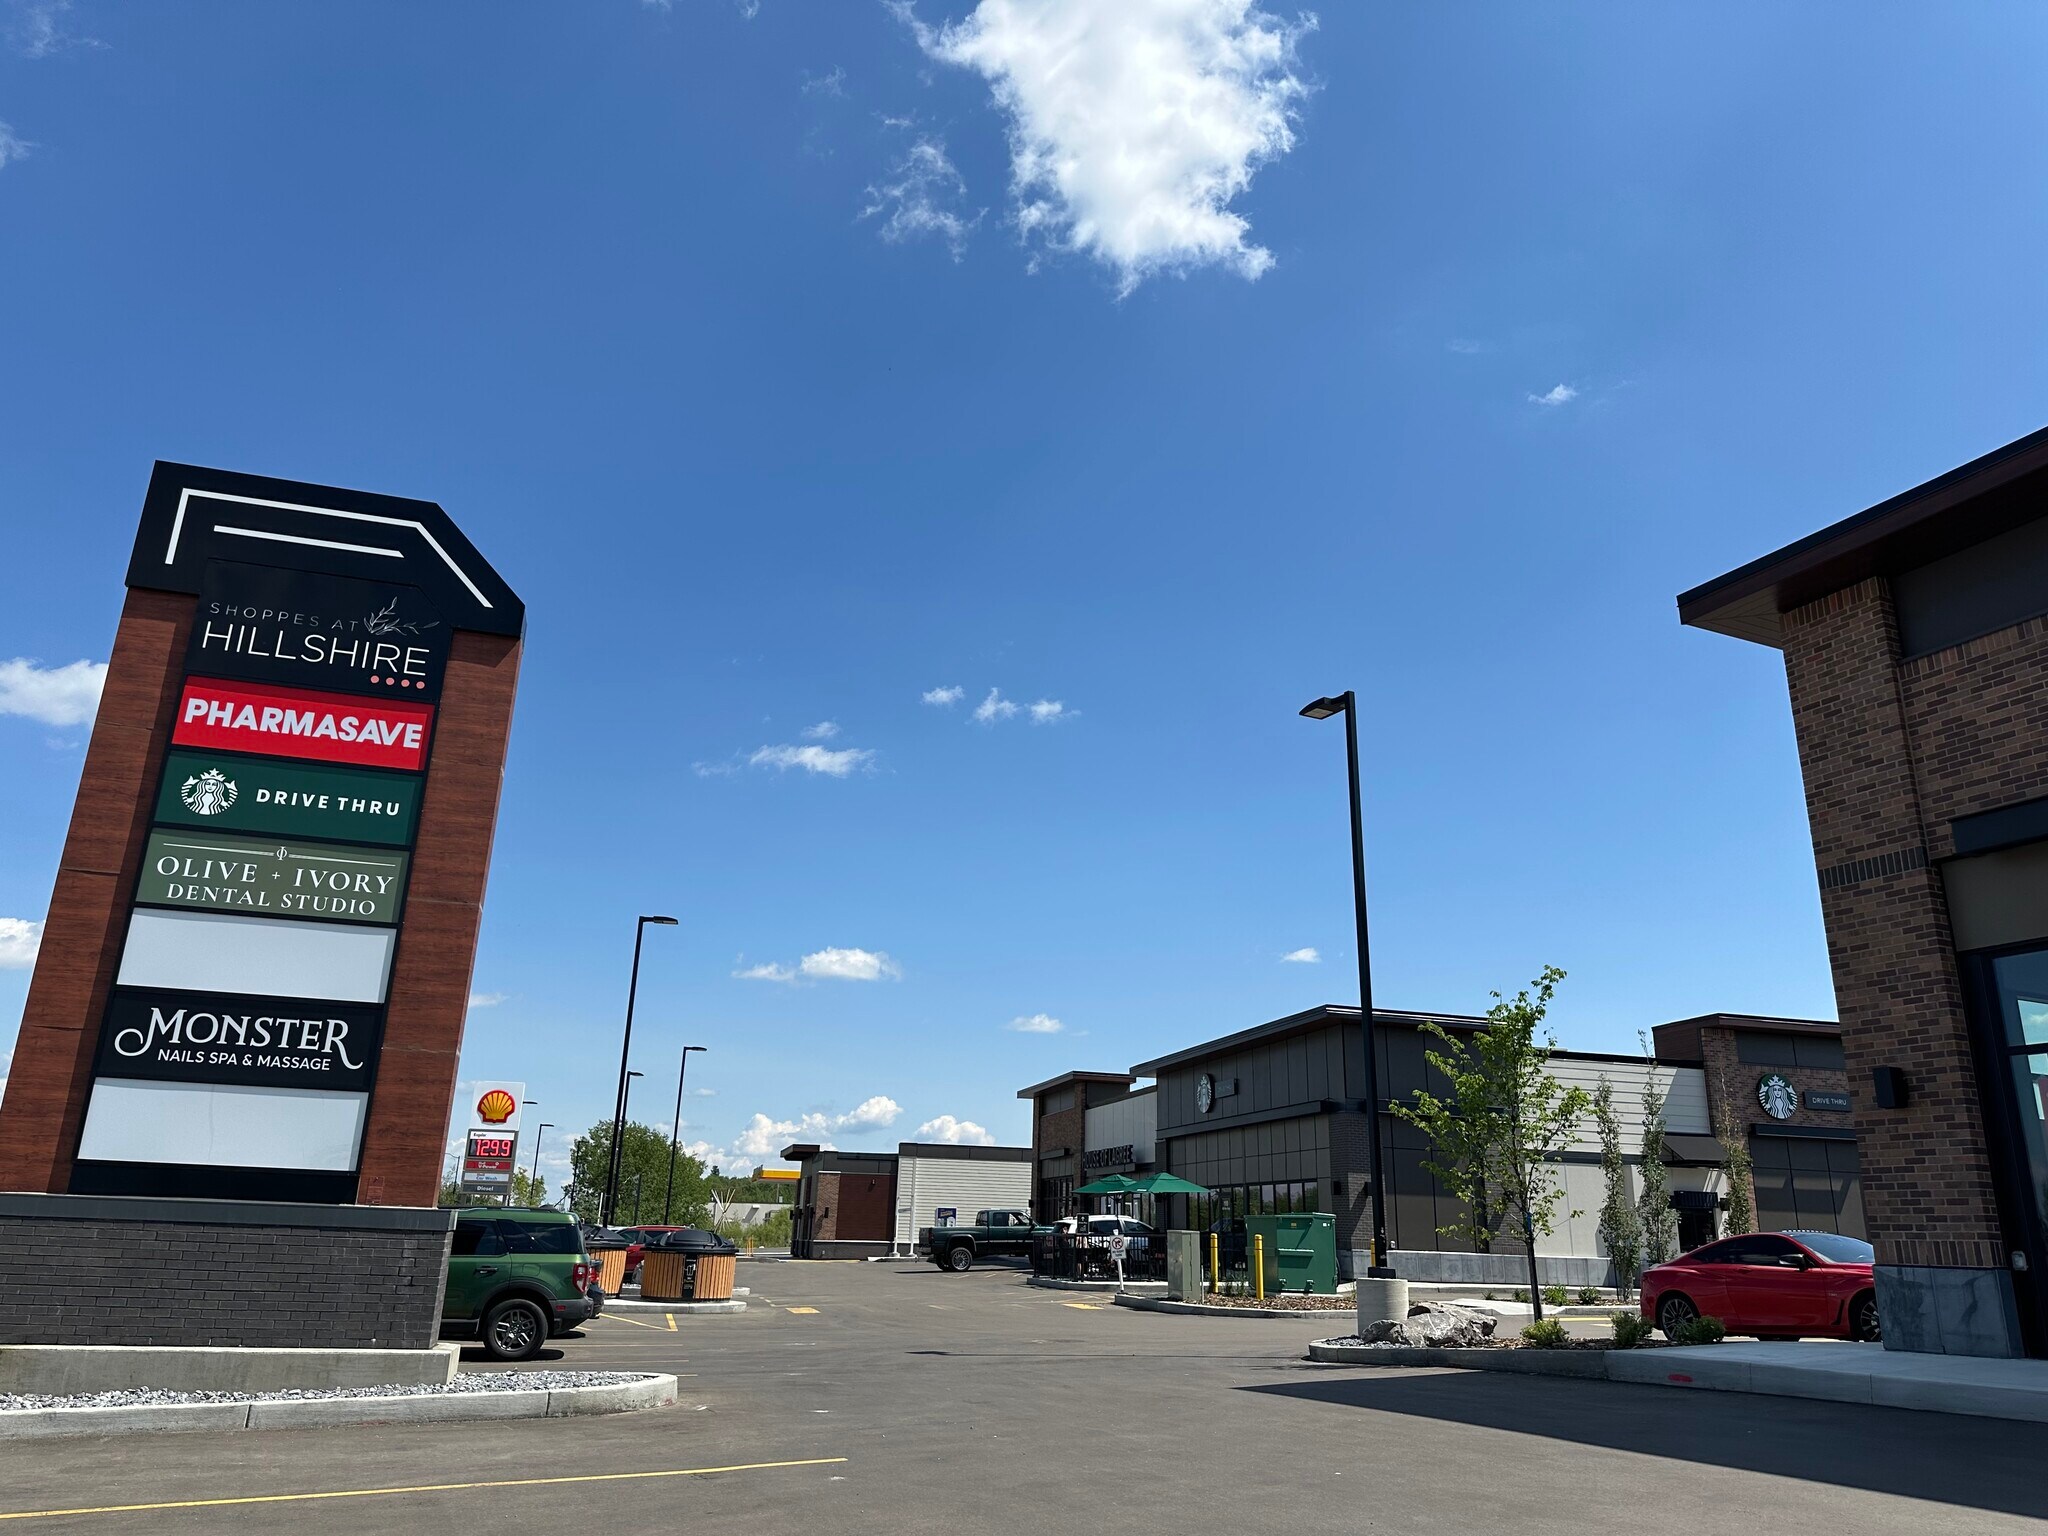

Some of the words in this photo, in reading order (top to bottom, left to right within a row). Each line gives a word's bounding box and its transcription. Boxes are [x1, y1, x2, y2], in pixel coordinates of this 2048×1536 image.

[209, 602, 319, 627] SHOPPES
[331, 618, 358, 632] AT
[202, 620, 430, 676] HILLSHIRE
[184, 697, 423, 749] PHARMASAVE
[256, 788, 328, 809] DRIVE
[338, 797, 400, 816] THRU
[156, 855, 258, 883] OLIVE
[293, 867, 394, 895] IVORY
[166, 883, 271, 907] DENTAL
[281, 892, 376, 916] STUDIO
[114, 1006, 363, 1070] MONSTER
[157, 1048, 204, 1063] NAILS
[208, 1051, 238, 1066] SPA
[242, 1053, 252, 1066] &
[256, 1055, 331, 1071] MASSAGE
[1812, 1097, 1830, 1105] DRIVE
[476, 1139, 511, 1156] 129.9
